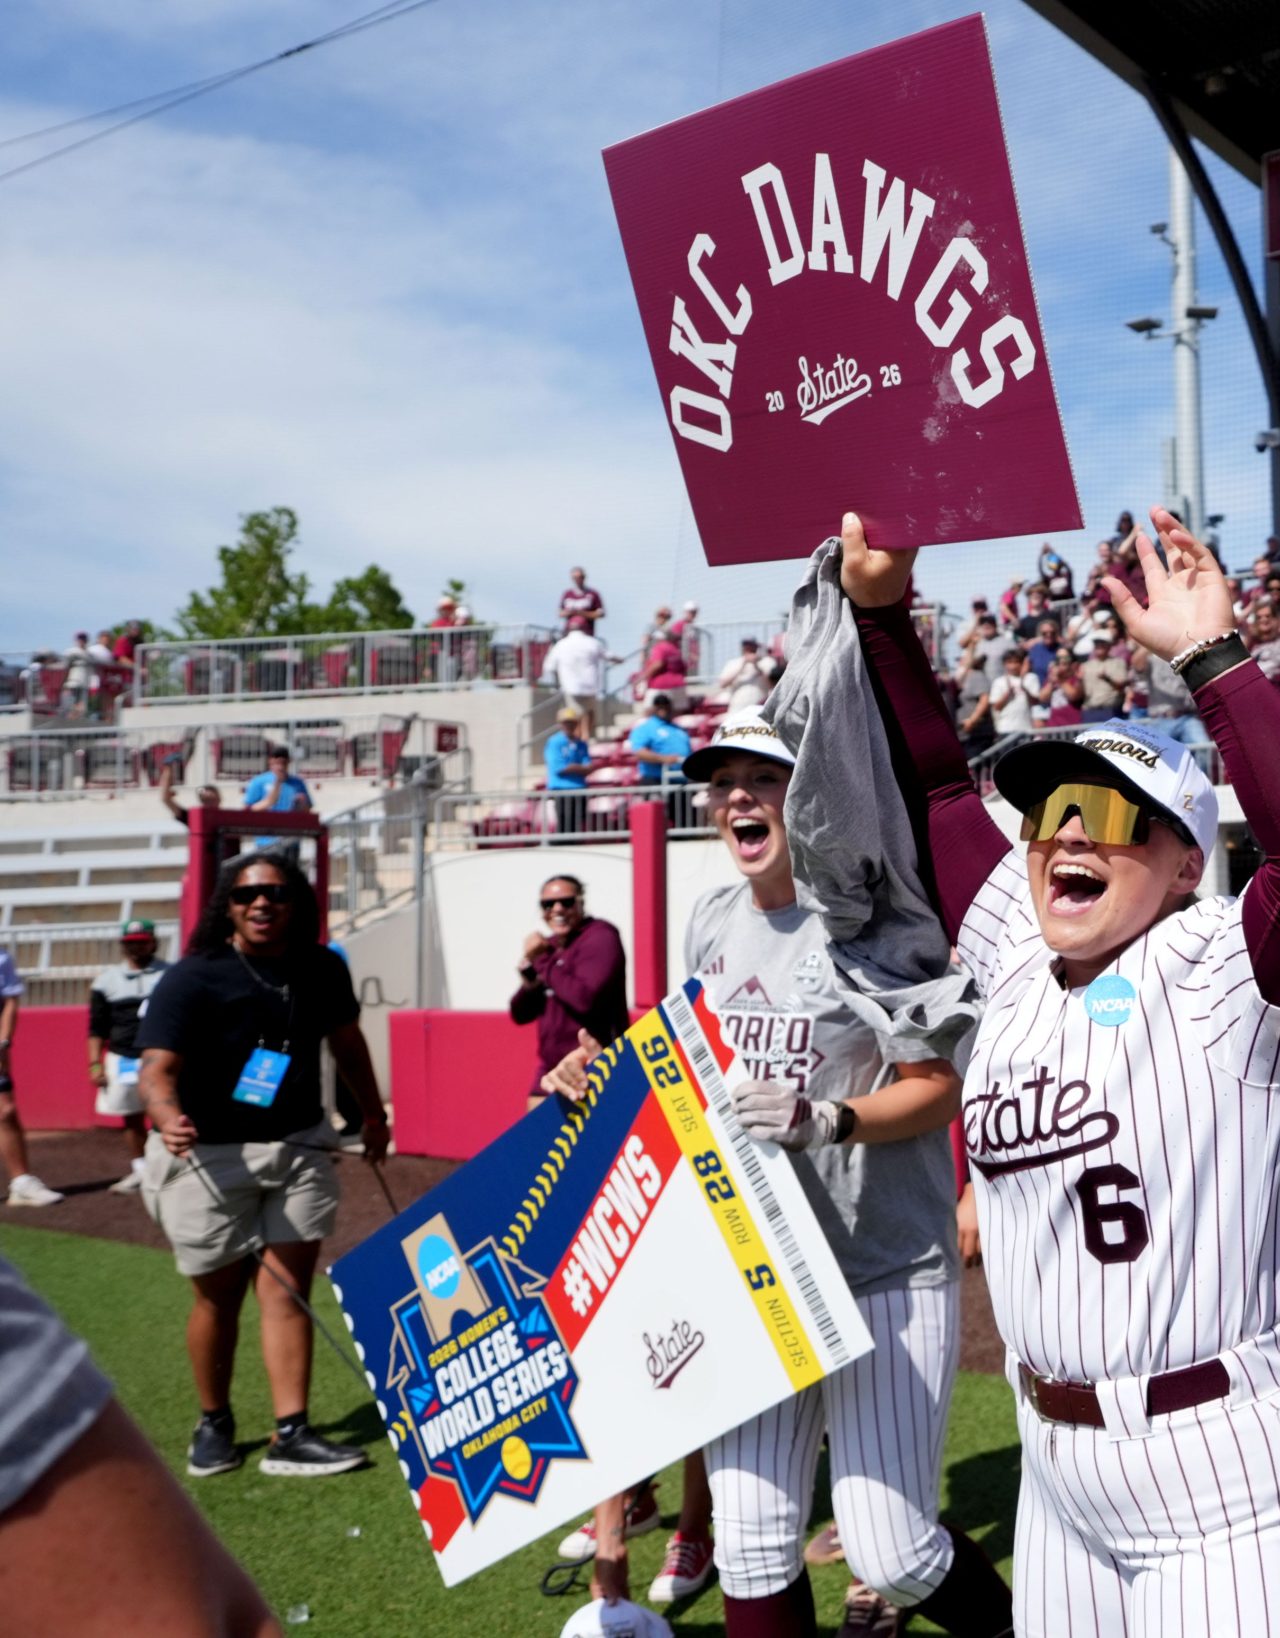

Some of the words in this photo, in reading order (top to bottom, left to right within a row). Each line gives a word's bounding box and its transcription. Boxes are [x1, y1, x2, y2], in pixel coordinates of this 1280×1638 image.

[669, 233, 753, 453] OKC
[741, 152, 1036, 409] DAWGS
[766, 390, 785, 413] 20
[797, 353, 872, 418] State
[879, 363, 902, 388] 26
[725, 1014, 810, 1055] ORLD
[1091, 999, 1136, 1014] NCAA
[641, 1034, 683, 1090] 26
[670, 1096, 699, 1133] SEAT
[693, 1150, 736, 1204] 28
[562, 1135, 662, 1318] #WCWS
[723, 1208, 751, 1246] ROW
[1074, 1163, 1149, 1265] 6
[424, 1254, 462, 1291] NCAA
[427, 1340, 458, 1369] 2026
[457, 1306, 509, 1351] WOMEN'S
[434, 1321, 524, 1405] COLLEGE
[644, 1319, 705, 1382] State
[765, 1298, 809, 1368] SECTION
[419, 1386, 496, 1459] WORLD
[491, 1340, 569, 1416] SERIES
[462, 1414, 521, 1460] OKLAHOMA
[521, 1397, 549, 1424] CITY
